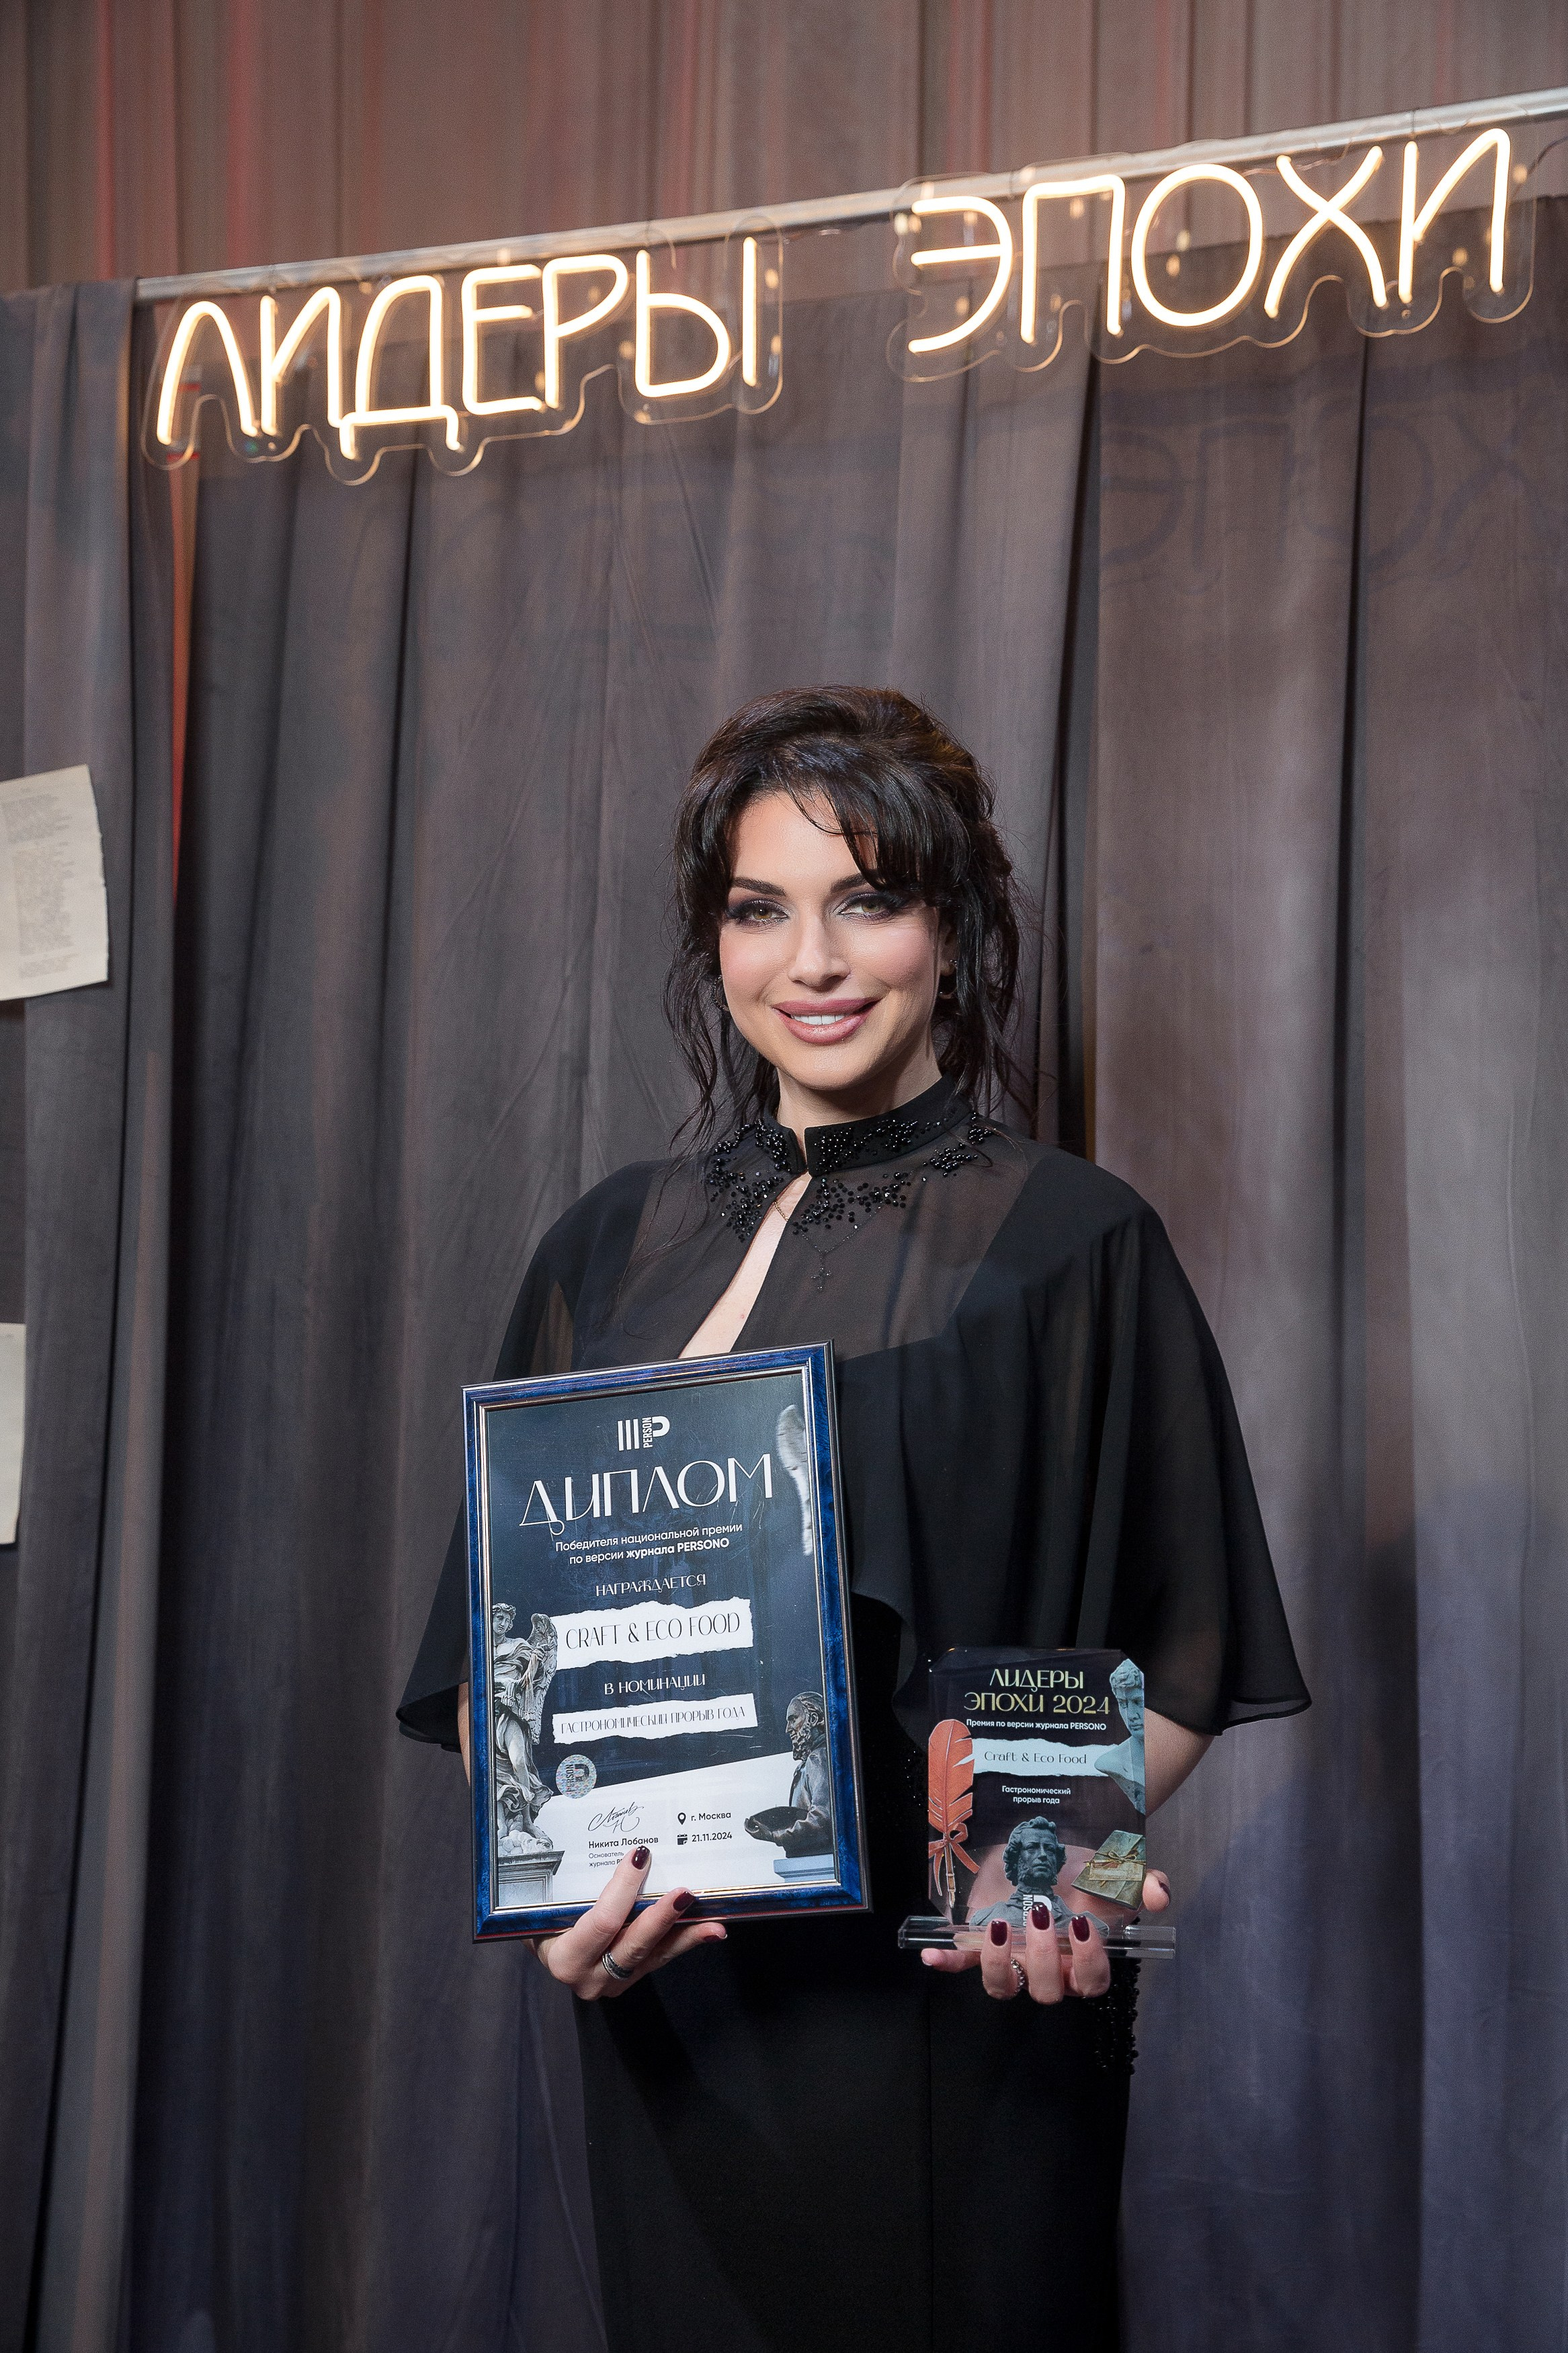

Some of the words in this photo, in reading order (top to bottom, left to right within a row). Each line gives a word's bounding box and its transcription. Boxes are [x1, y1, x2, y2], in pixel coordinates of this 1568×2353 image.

[157, 237, 757, 460] ЛИДЕРЫ
[908, 128, 1511, 354] ЭПОХИ
[642, 1417, 653, 1448] PERSON
[519, 1453, 773, 1536] ДИПЛОМ
[555, 1537, 618, 1552] Победителя
[621, 1527, 700, 1544] национальной
[702, 1523, 743, 1536] премии
[569, 1555, 583, 1564] по
[585, 1552, 624, 1564] версии
[626, 1545, 675, 1559] журнала
[677, 1538, 730, 1553] PERSONO
[595, 1574, 706, 1597] НАГРАЖДАЕТСЯ
[566, 1624, 621, 1649] CRAFT
[628, 1622, 639, 1643] &
[646, 1618, 682, 1641] ECO
[690, 1611, 740, 1636] FOOD
[604, 1683, 614, 1695] В
[618, 1674, 705, 1694] НОМИНАЦИИ
[989, 1669, 1083, 1692] ЛИДЕРЫ
[964, 1691, 1044, 1712] ЭПОХИ
[1053, 1695, 1110, 1714] 2024
[561, 1713, 667, 1734] ГАСТРОНОМИЧЕСКИЙ
[671, 1708, 714, 1724] ПРОРЫВ
[717, 1706, 745, 1721] ГОДА
[966, 1718, 994, 1727] Премия
[1070, 1722, 1107, 1730] PERSONO
[984, 1751, 1017, 1762] Craft
[1022, 1752, 1030, 1762] &
[1034, 1753, 1055, 1763] Eco
[1059, 1753, 1087, 1764] Food
[1001, 1785, 1071, 1795] Гастрономический
[1013, 1796, 1041, 1804] прорыв
[1042, 1796, 1060, 1804] года
[698, 1812, 731, 1821] Москва
[589, 1840, 619, 1849] Никита
[621, 1837, 659, 1846] Лобанов
[692, 1831, 732, 1842] 21.11.2024
[589, 1851, 624, 1859] Основатель
[589, 1860, 615, 1868] журнала
